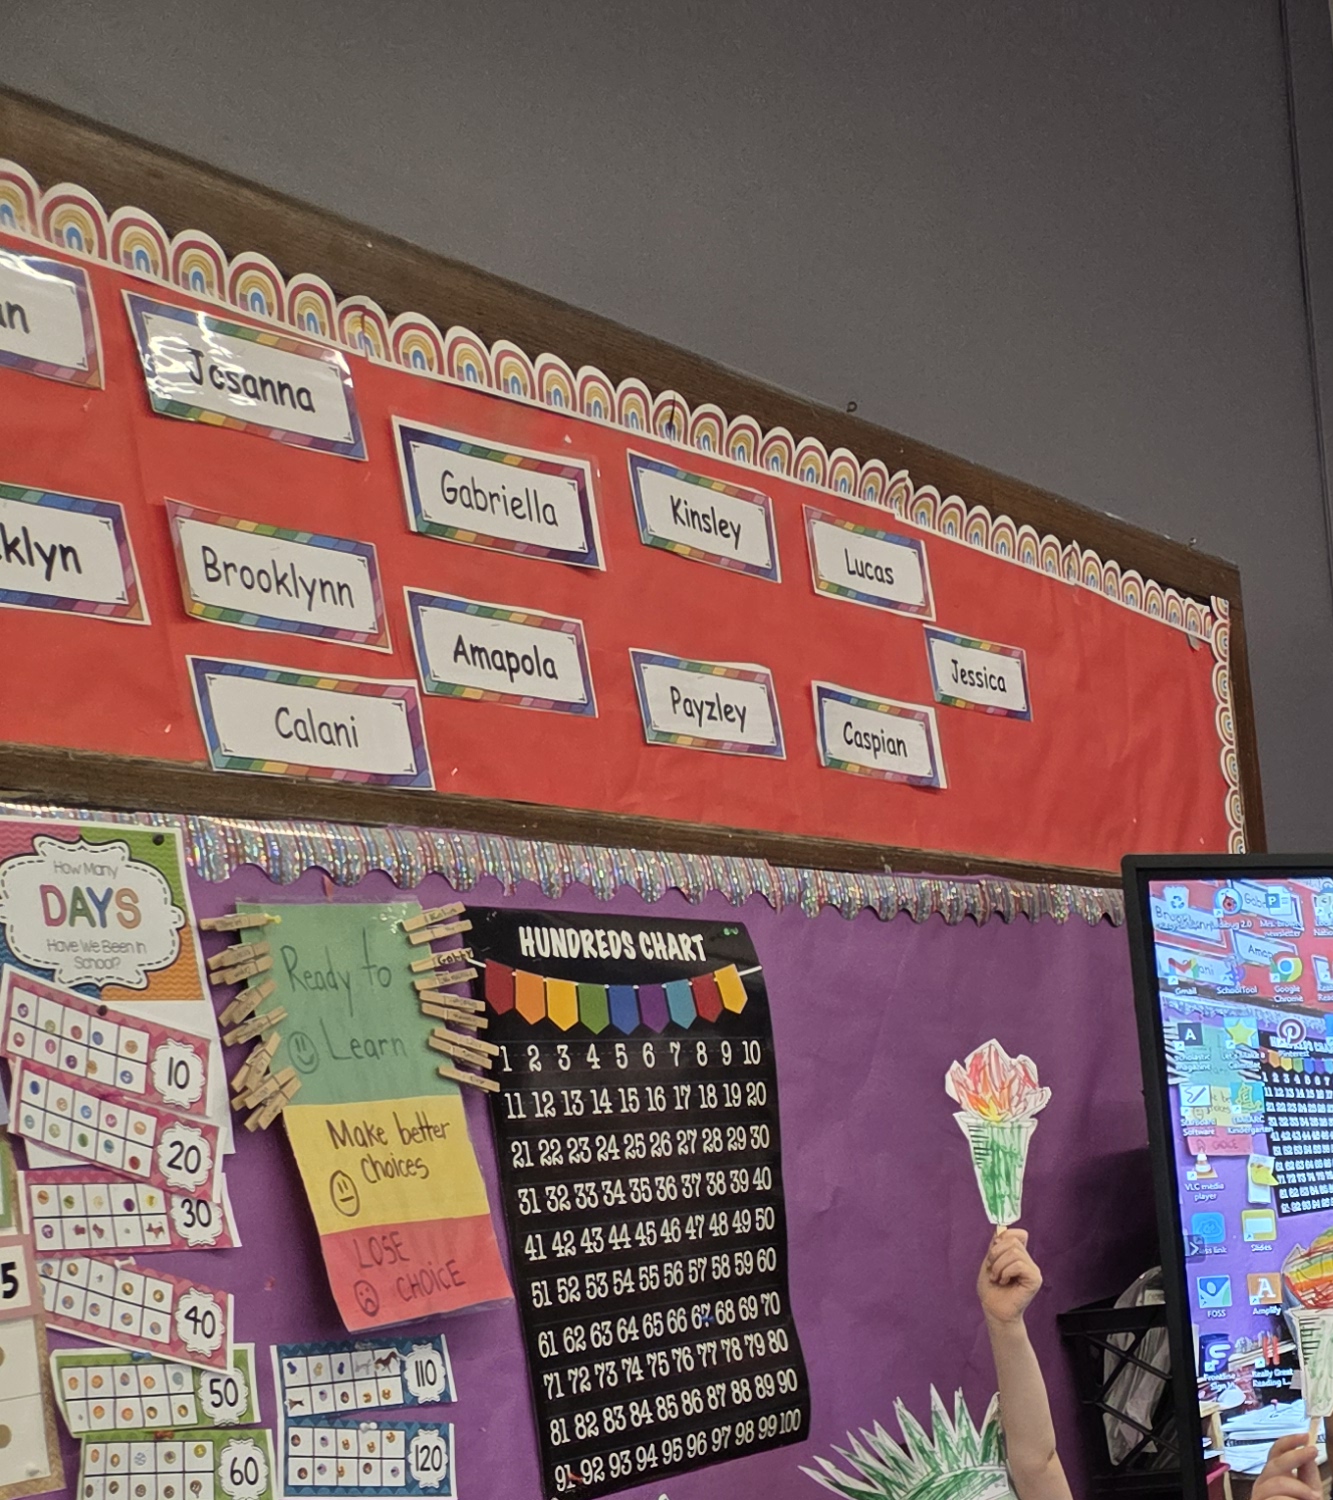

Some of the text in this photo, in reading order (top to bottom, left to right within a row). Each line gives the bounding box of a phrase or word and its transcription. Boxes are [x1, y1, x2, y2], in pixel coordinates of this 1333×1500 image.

[441, 471, 558, 527] Gabriella
[670, 495, 741, 545] Kinsley
[0, 523, 82, 581] klyn
[845, 549, 895, 586] Lucas
[202, 546, 354, 611] Brooklynn
[453, 636, 558, 682] Amapola
[951, 659, 1007, 694] Jessica
[274, 707, 358, 748] Calani
[670, 687, 746, 732] Payzley
[843, 723, 908, 759] Caspian
[54, 861, 118, 879] How Many
[39, 884, 141, 930] DAYS
[47, 939, 78, 953] Have
[80, 940, 99, 953] We
[102, 940, 134, 953] Been
[518, 926, 707, 962] HUNDREDS CHART
[74, 956, 121, 970] School?
[281, 928, 392, 1015] Ready to
[319, 1018, 407, 1060] Learn
[501, 1040, 761, 1072] 1 2 3 4 5 6 7 8 9 10
[167, 1057, 190, 1088] 10
[326, 1111, 450, 1149] Make better
[168, 1140, 201, 1174] 20
[179, 1199, 212, 1228] 30
[353, 1231, 410, 1268] LOSE
[183, 1305, 216, 1341] 40
[1207, 1309, 1226, 1318] FOSS
[414, 1357, 437, 1388] 110
[208, 1377, 239, 1409] 50
[229, 1454, 259, 1486] 60
[414, 1443, 442, 1474] 120
